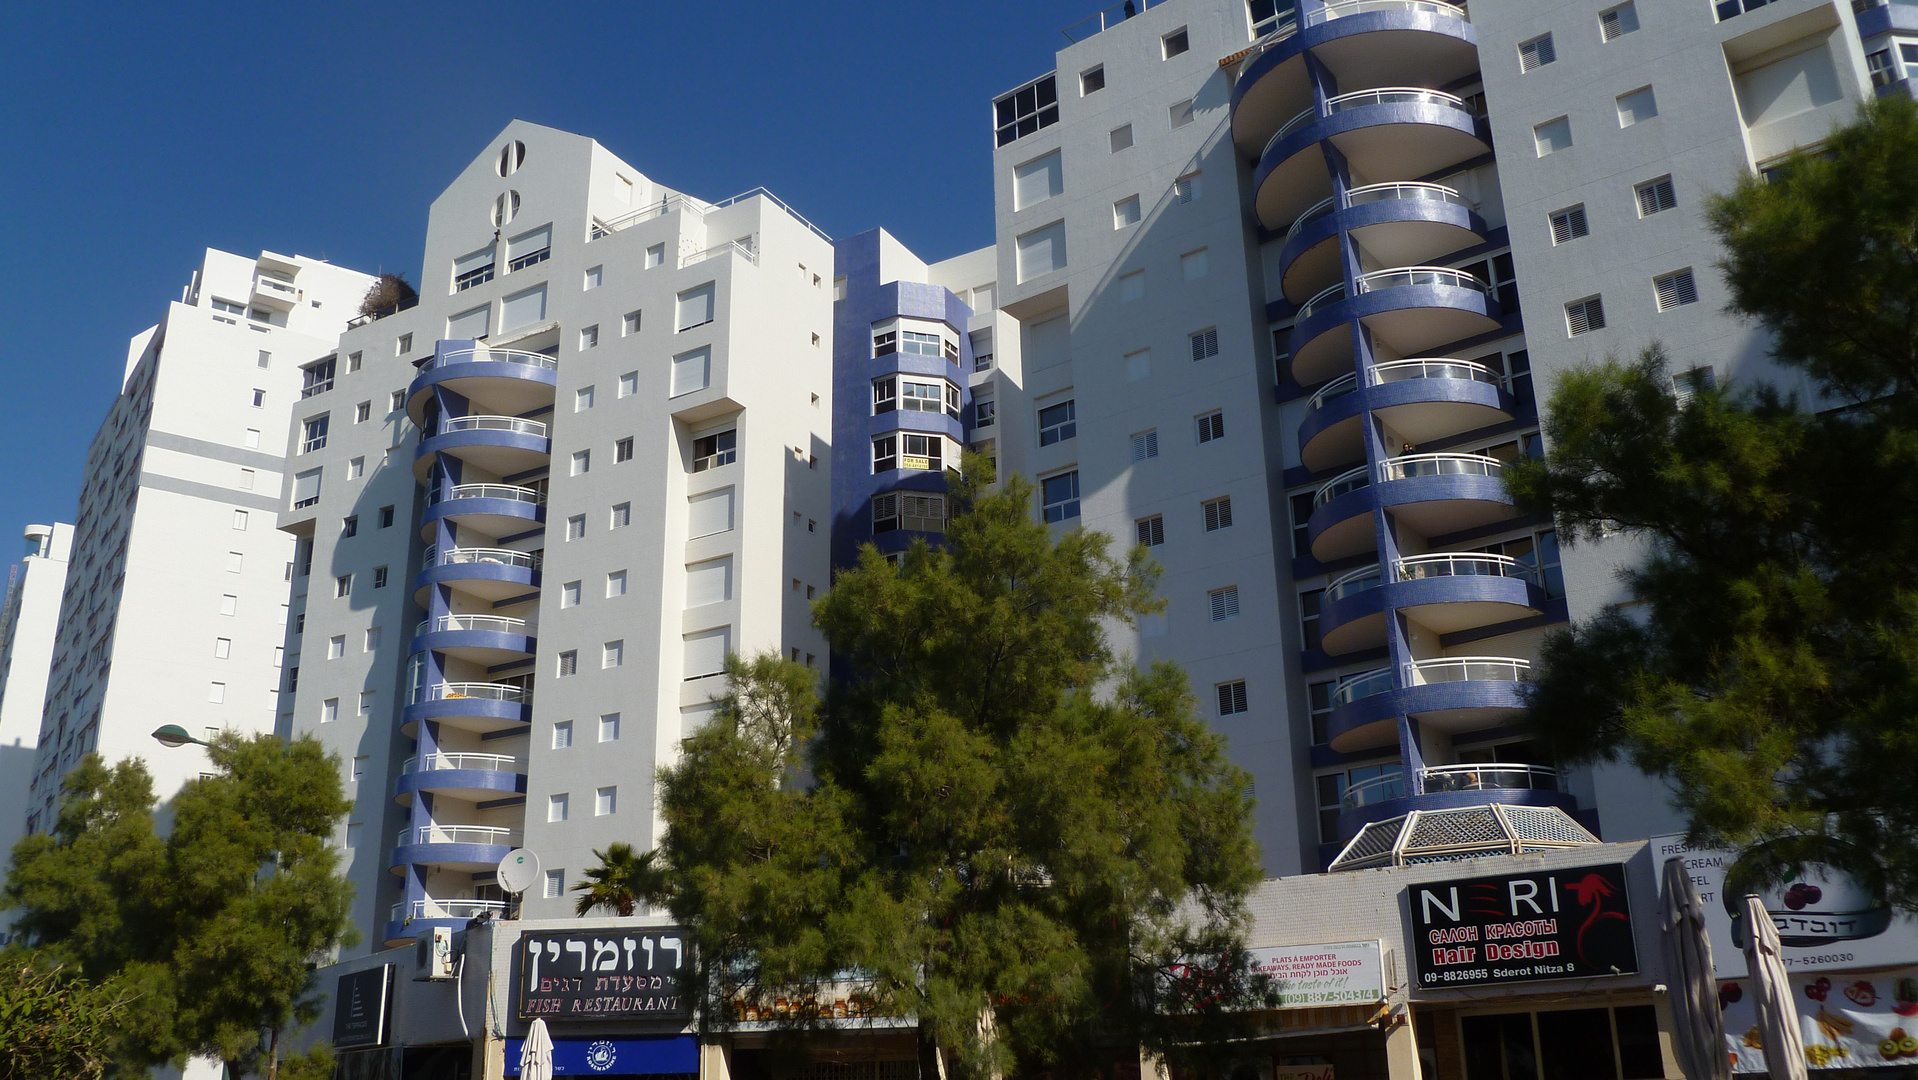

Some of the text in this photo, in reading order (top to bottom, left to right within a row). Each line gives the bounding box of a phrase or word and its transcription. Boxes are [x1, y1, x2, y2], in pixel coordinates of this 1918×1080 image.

[1661, 843, 1697, 855] FRESH
[1421, 877, 1559, 924] NERI
[1429, 919, 1558, 944] САЛОН КРАСОТЫ
[1772, 918, 1857, 934] דובדב
[1299, 954, 1336, 962] EMPORTER
[1432, 940, 1560, 966] Hair Design
[1781, 953, 1855, 966] 77-5260030
[529, 936, 683, 993] רוזמרין
[1292, 962, 1315, 970] READY
[1337, 959, 1362, 967] FOODS
[1290, 970, 1311, 978] לקחת
[1313, 970, 1329, 978] מוכן
[1424, 962, 1575, 983] 09-8826955 Sderot Nitza 8
[541, 975, 663, 992] מסעדת דגים
[1297, 979, 1322, 990] taste
[1323, 977, 1335, 988] of
[526, 995, 682, 1013] FISH RESTAURANT
[1285, 993, 1305, 1003] (09)
